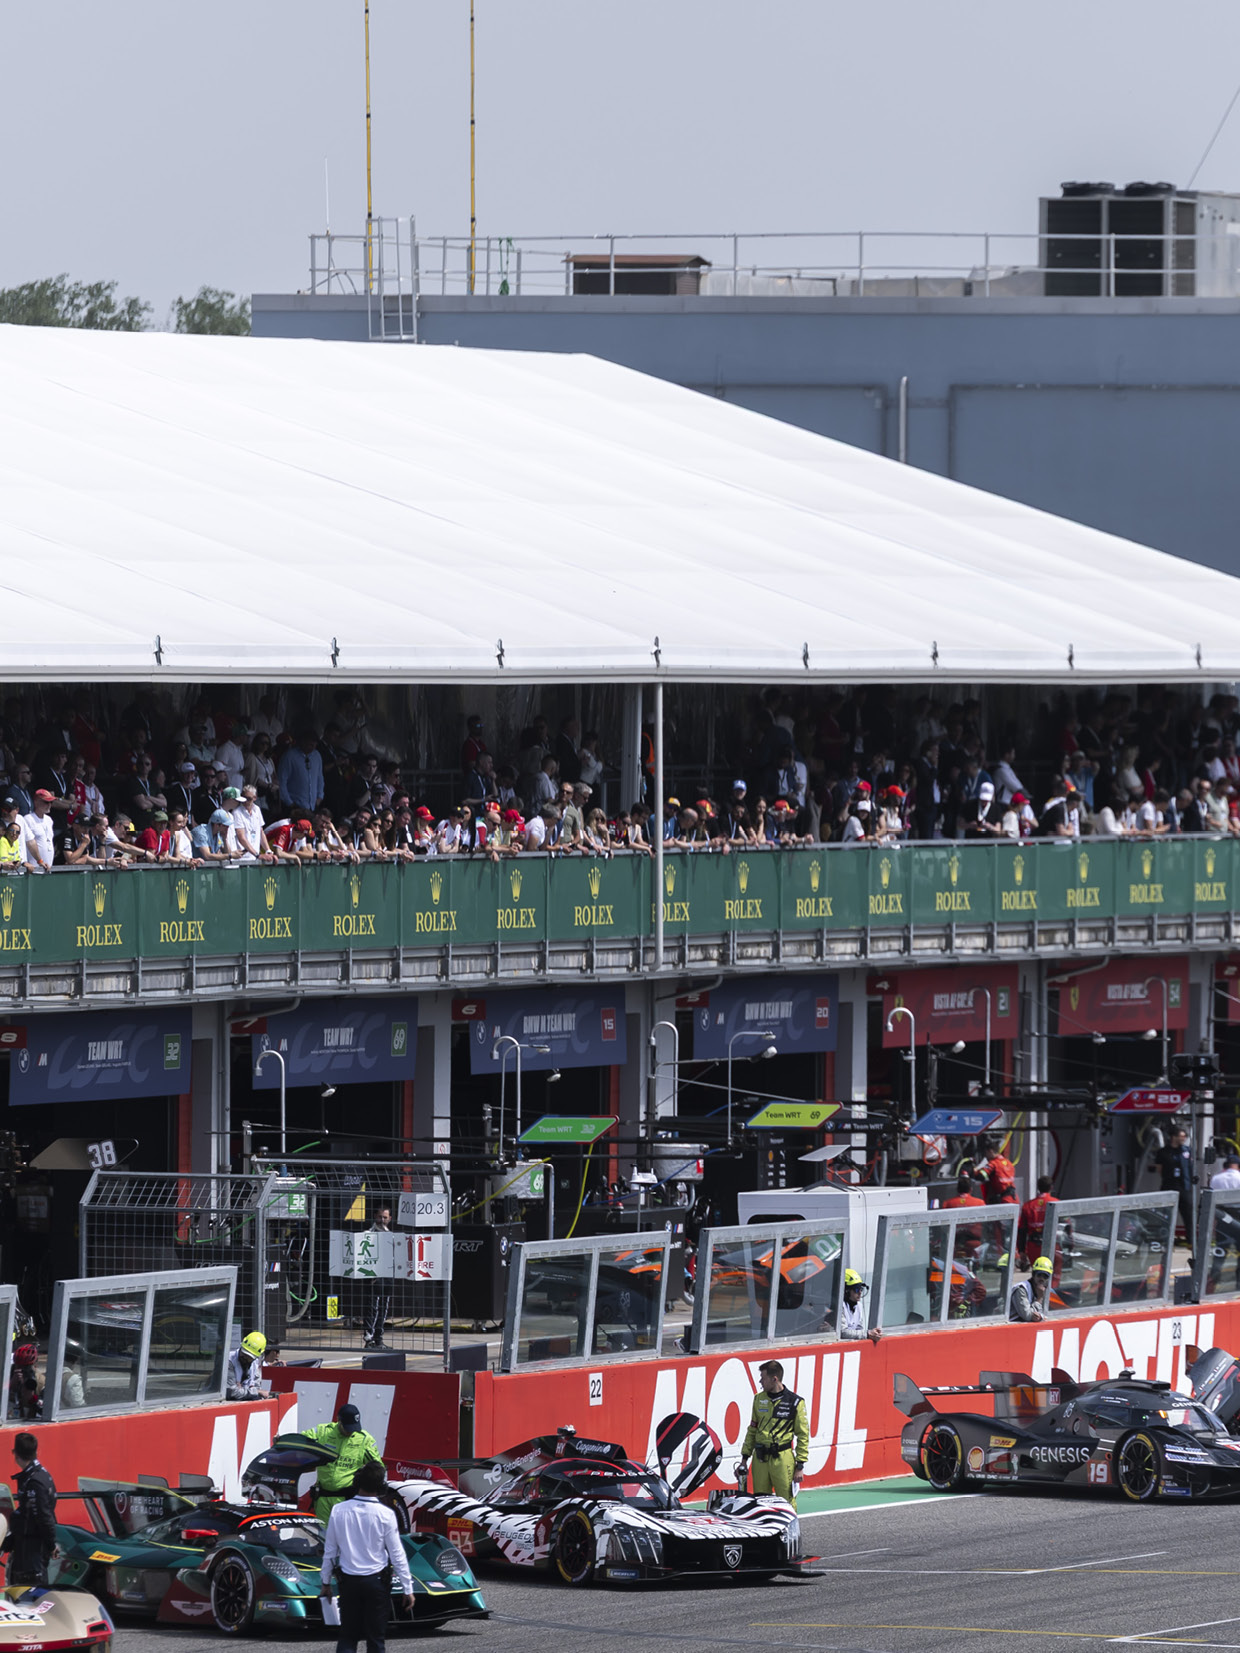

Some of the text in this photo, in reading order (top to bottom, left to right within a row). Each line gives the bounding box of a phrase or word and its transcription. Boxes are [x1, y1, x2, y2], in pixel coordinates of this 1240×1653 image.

[868, 894, 903, 914] ROLEX
[936, 892, 971, 911] ROLEX
[1002, 890, 1037, 909] ROLEX
[1066, 888, 1099, 907] ROLEX
[574, 905, 614, 926] ROLEX
[724, 899, 762, 919] ROLEX
[795, 898, 833, 918] ROLEX
[249, 917, 292, 939] ROLEX
[333, 914, 376, 936] ROLEX
[415, 911, 457, 932] ROLEX
[497, 908, 536, 929] ROLEX
[76, 924, 122, 947] ROLEX
[160, 920, 205, 942] ROLEX
[461, 1004, 478, 1015] 6
[816, 1007, 829, 1019] 20
[547, 1014, 562, 1032] TEAM
[562, 1013, 576, 1031] WRT
[603, 1018, 614, 1031] 15
[323, 1027, 354, 1047] TEAM WRT
[392, 1028, 406, 1050] 69
[88, 1040, 124, 1061] TEAM WRT
[165, 1042, 180, 1061] 32
[1157, 1094, 1182, 1104] 20
[785, 1111, 802, 1119] WRT
[810, 1111, 821, 1120] 69
[963, 1115, 983, 1126] 15
[538, 1126, 555, 1134] Team
[87, 1140, 117, 1169] 38
[401, 1200, 416, 1214] 20.3
[417, 1202, 444, 1215] 20.3
[1172, 1322, 1182, 1339] 23
[590, 1378, 603, 1399] 22
[1050, 1388, 1060, 1401] HY
[556, 1442, 565, 1454] HY
[1029, 1446, 1090, 1463] GENESIS
[502, 1447, 541, 1473] TotalEnergies
[590, 1468, 655, 1478] PEUGEO
[1090, 1463, 1108, 1483] 19
[130, 1496, 164, 1506] THE HEART
[130, 1505, 164, 1516] OF RACING
[250, 1517, 293, 1530] ASTON
[450, 1530, 475, 1554] 93
